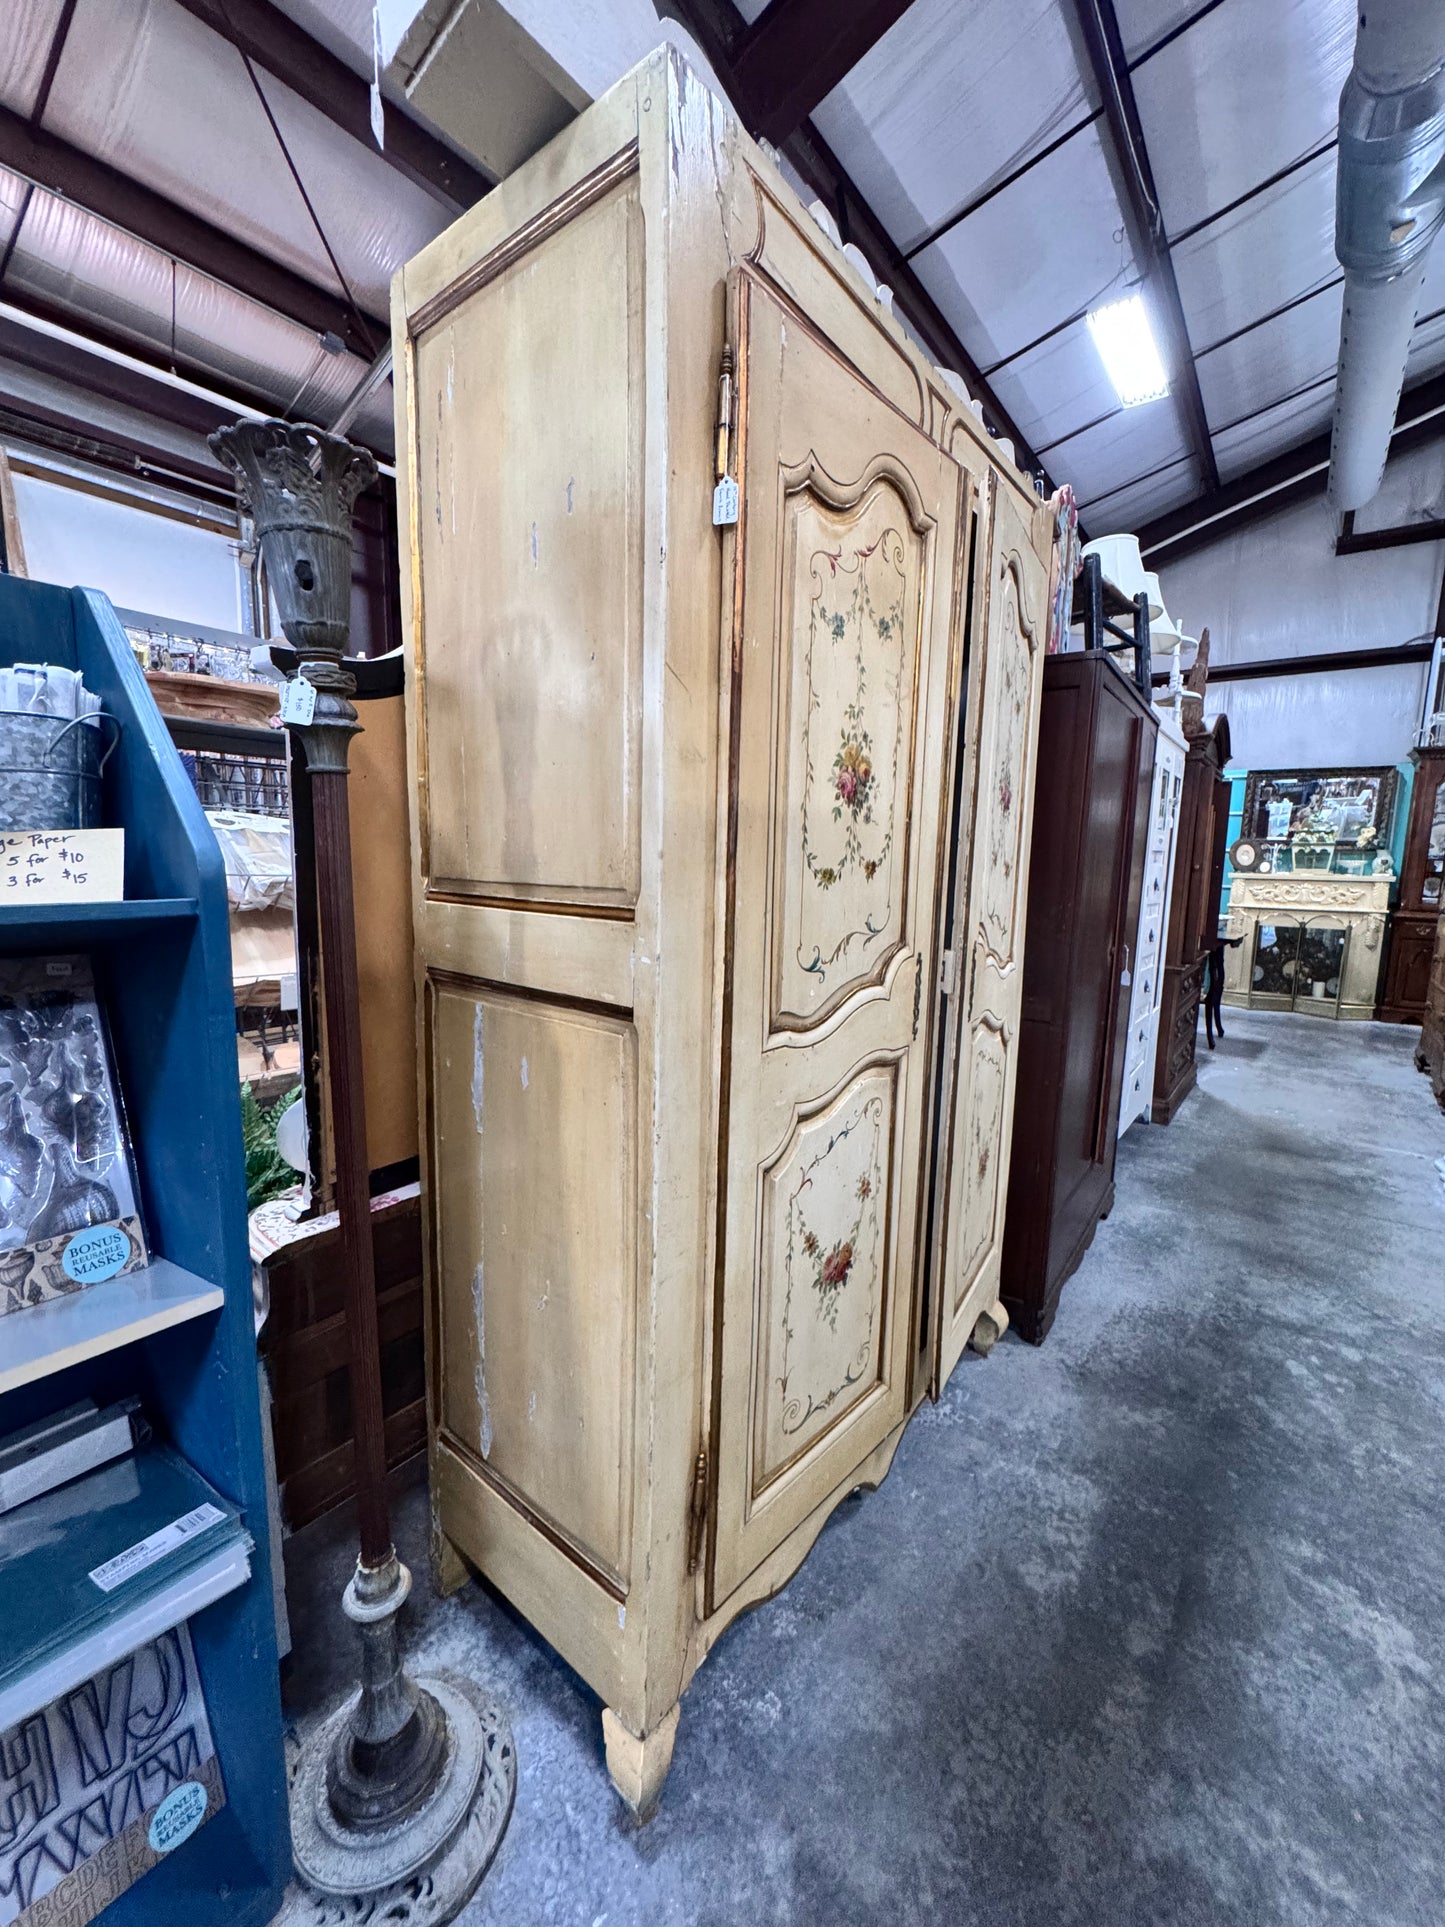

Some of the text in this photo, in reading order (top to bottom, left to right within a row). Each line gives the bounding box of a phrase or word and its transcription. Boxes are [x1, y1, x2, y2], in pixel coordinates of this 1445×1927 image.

[27, 833, 76, 849] Paper
[6, 848, 84, 867] 5 for $10
[6, 868, 88, 887] 3 for $15
[69, 1232, 122, 1258] BONUS
[72, 1243, 123, 1266] REUSABLE
[73, 1250, 126, 1277] MASKS
[154, 1786, 200, 1831] BONUS
[158, 1805, 203, 1848] MASKS
